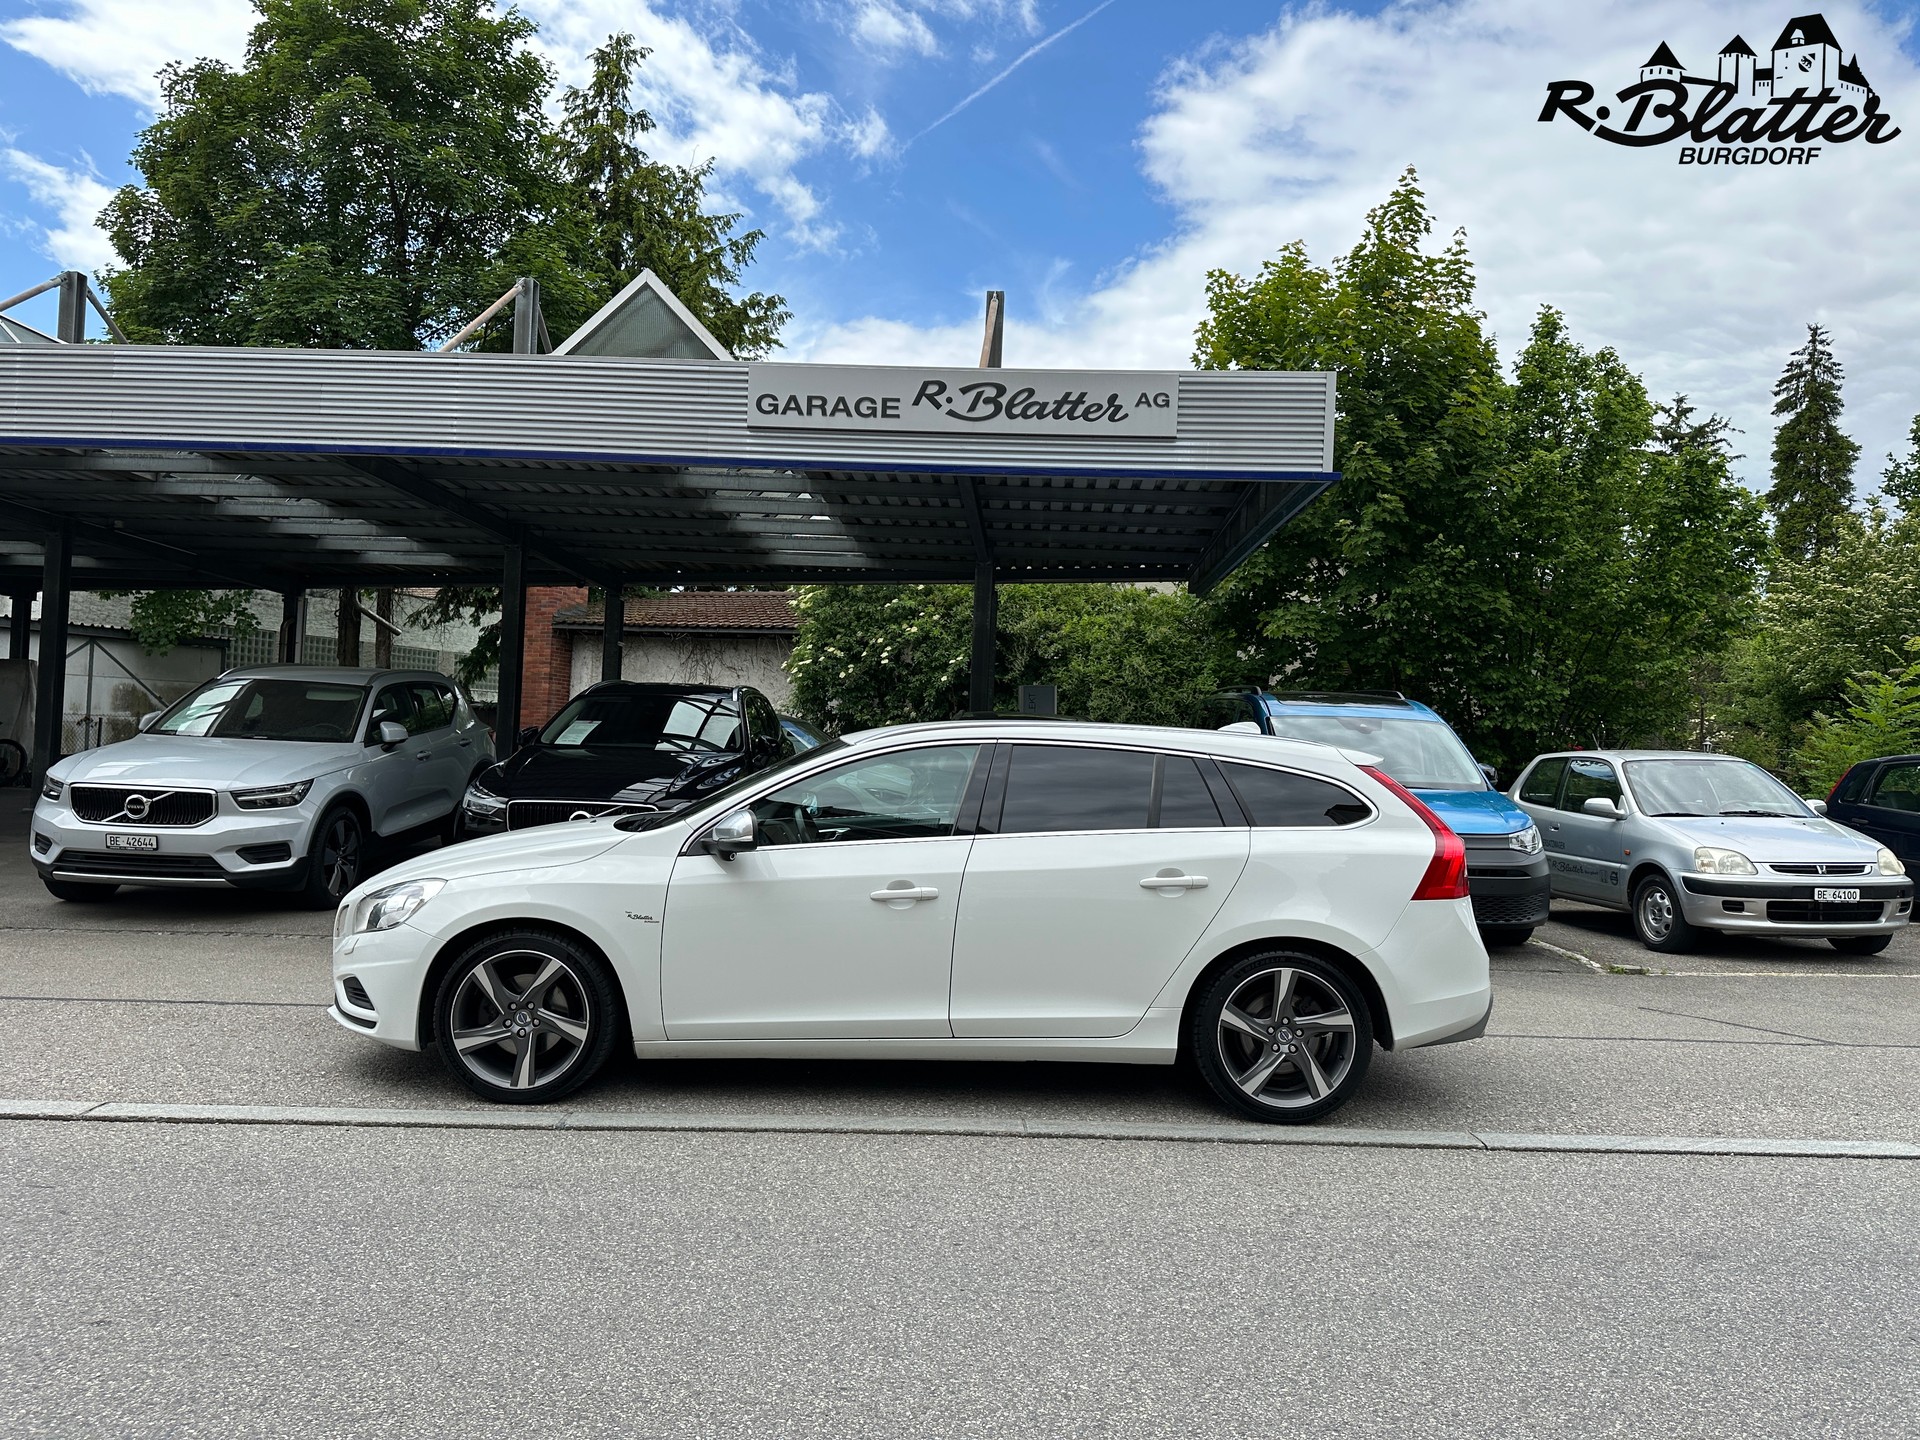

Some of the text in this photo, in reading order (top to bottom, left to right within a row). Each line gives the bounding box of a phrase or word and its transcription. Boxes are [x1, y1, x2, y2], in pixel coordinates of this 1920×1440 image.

[755, 393, 900, 419] GARAGE
[1135, 391, 1170, 408] AG
[126, 837, 153, 847] 42644
[1832, 890, 1857, 900] 64100
